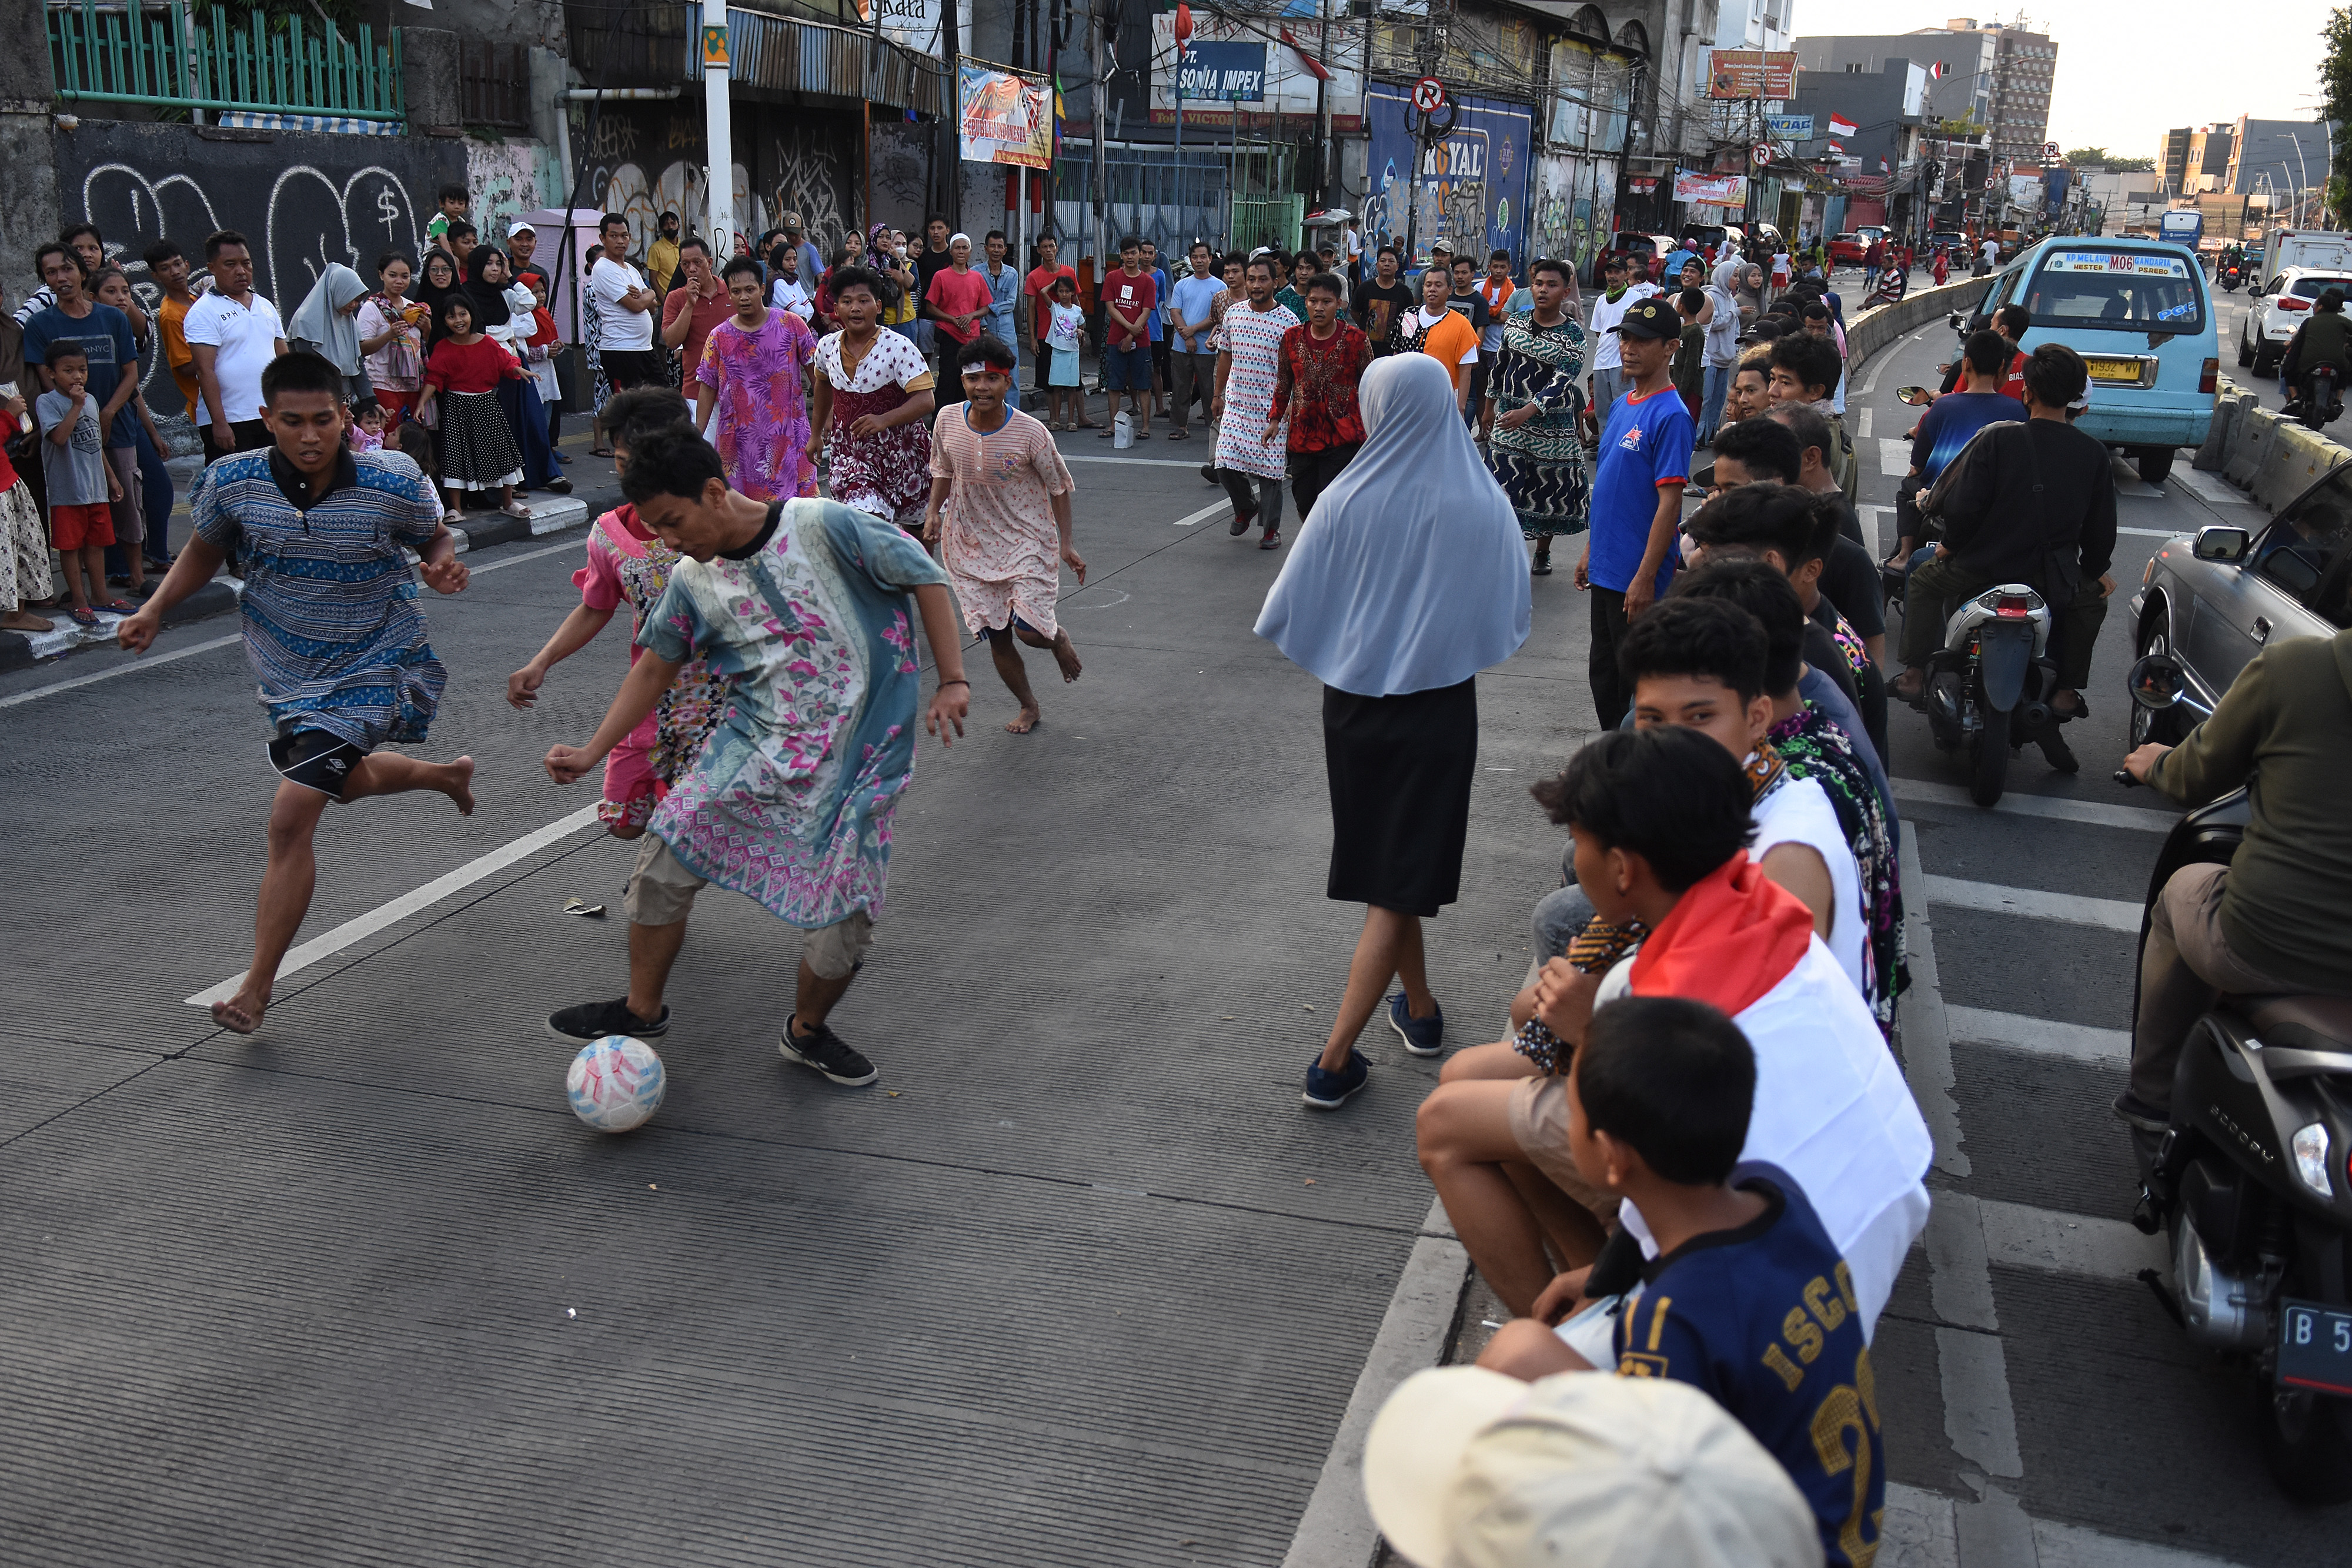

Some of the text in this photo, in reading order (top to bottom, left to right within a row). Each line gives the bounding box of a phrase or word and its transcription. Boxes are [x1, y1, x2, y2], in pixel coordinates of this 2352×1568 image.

[1182, 51, 1197, 63] PT.
[1222, 70, 1261, 91] IMPEX
[1188, 113, 1244, 126] VICTORY
[997, 123, 1027, 143] INDONESIA
[1423, 142, 1481, 176] ROYAL
[1676, 185, 1700, 195] REPUBLIK
[1700, 188, 1725, 198] INDONESIA
[1726, 178, 1739, 195] 77
[2066, 253, 2076, 262] KP
[2077, 253, 2110, 263] MELAYU
[2134, 257, 2170, 266] GANDARIA
[220, 310, 238, 321] BPH
[2157, 302, 2197, 320] PGC
[2125, 362, 2138, 373] WV
[2210, 1104, 2274, 1164] SCOOPY
[2296, 1314, 2312, 1345] B
